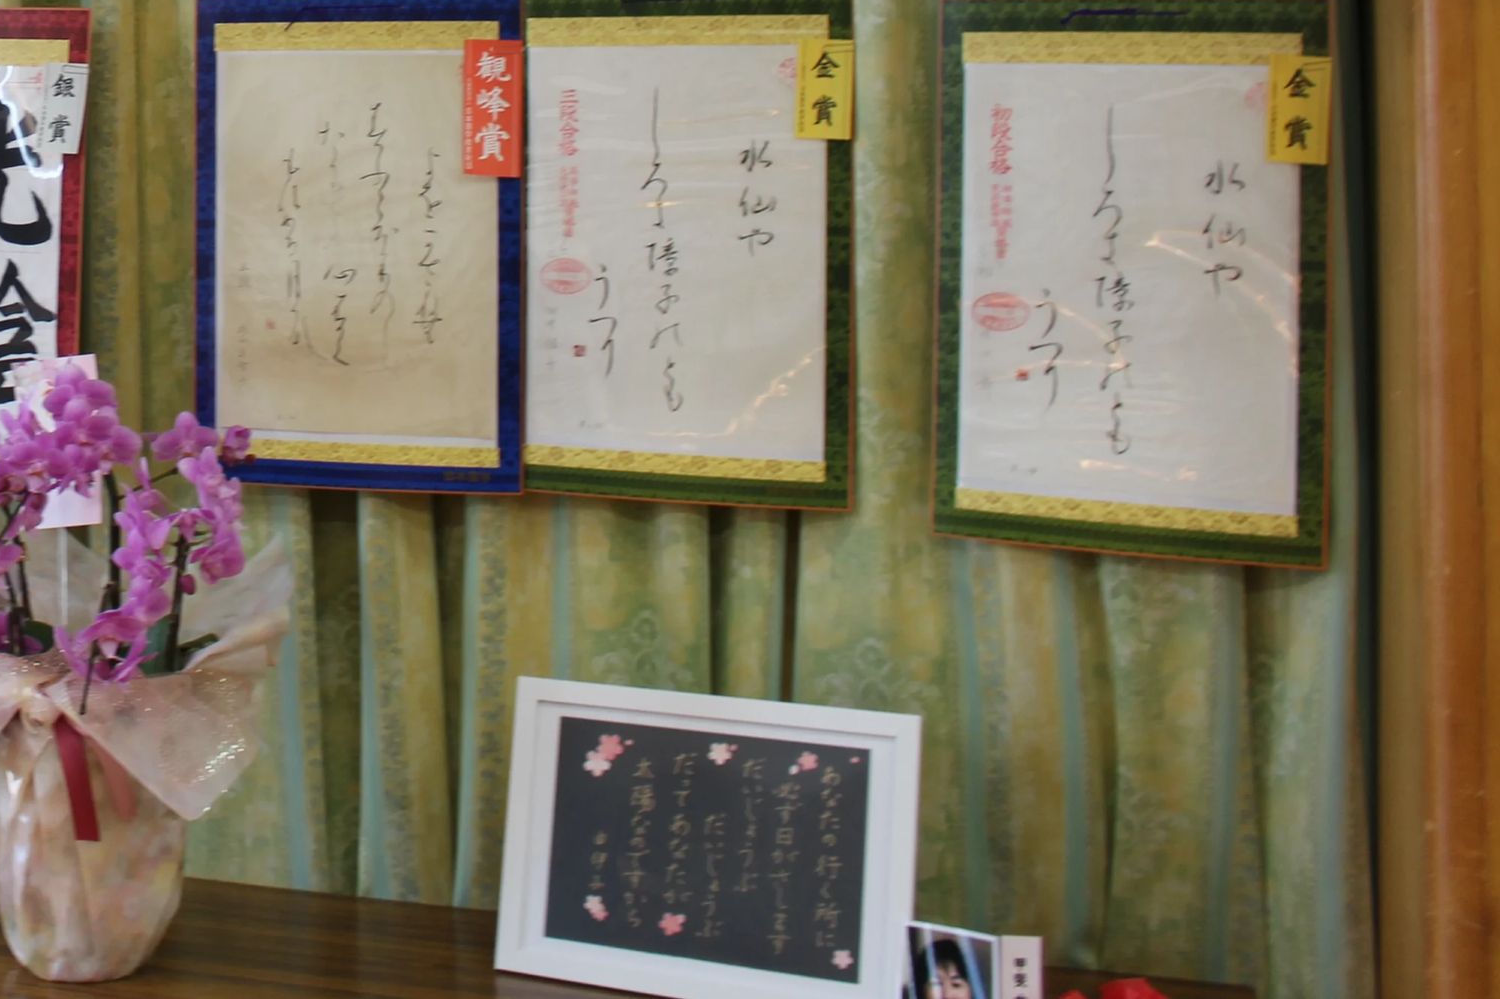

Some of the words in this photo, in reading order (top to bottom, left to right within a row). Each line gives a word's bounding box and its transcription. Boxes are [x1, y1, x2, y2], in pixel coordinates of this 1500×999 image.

[47, 72, 77, 144] 銀賞
[474, 50, 512, 163] 観峰賞
[811, 51, 840, 127] 金賞
[1283, 67, 1316, 150] 金賞
